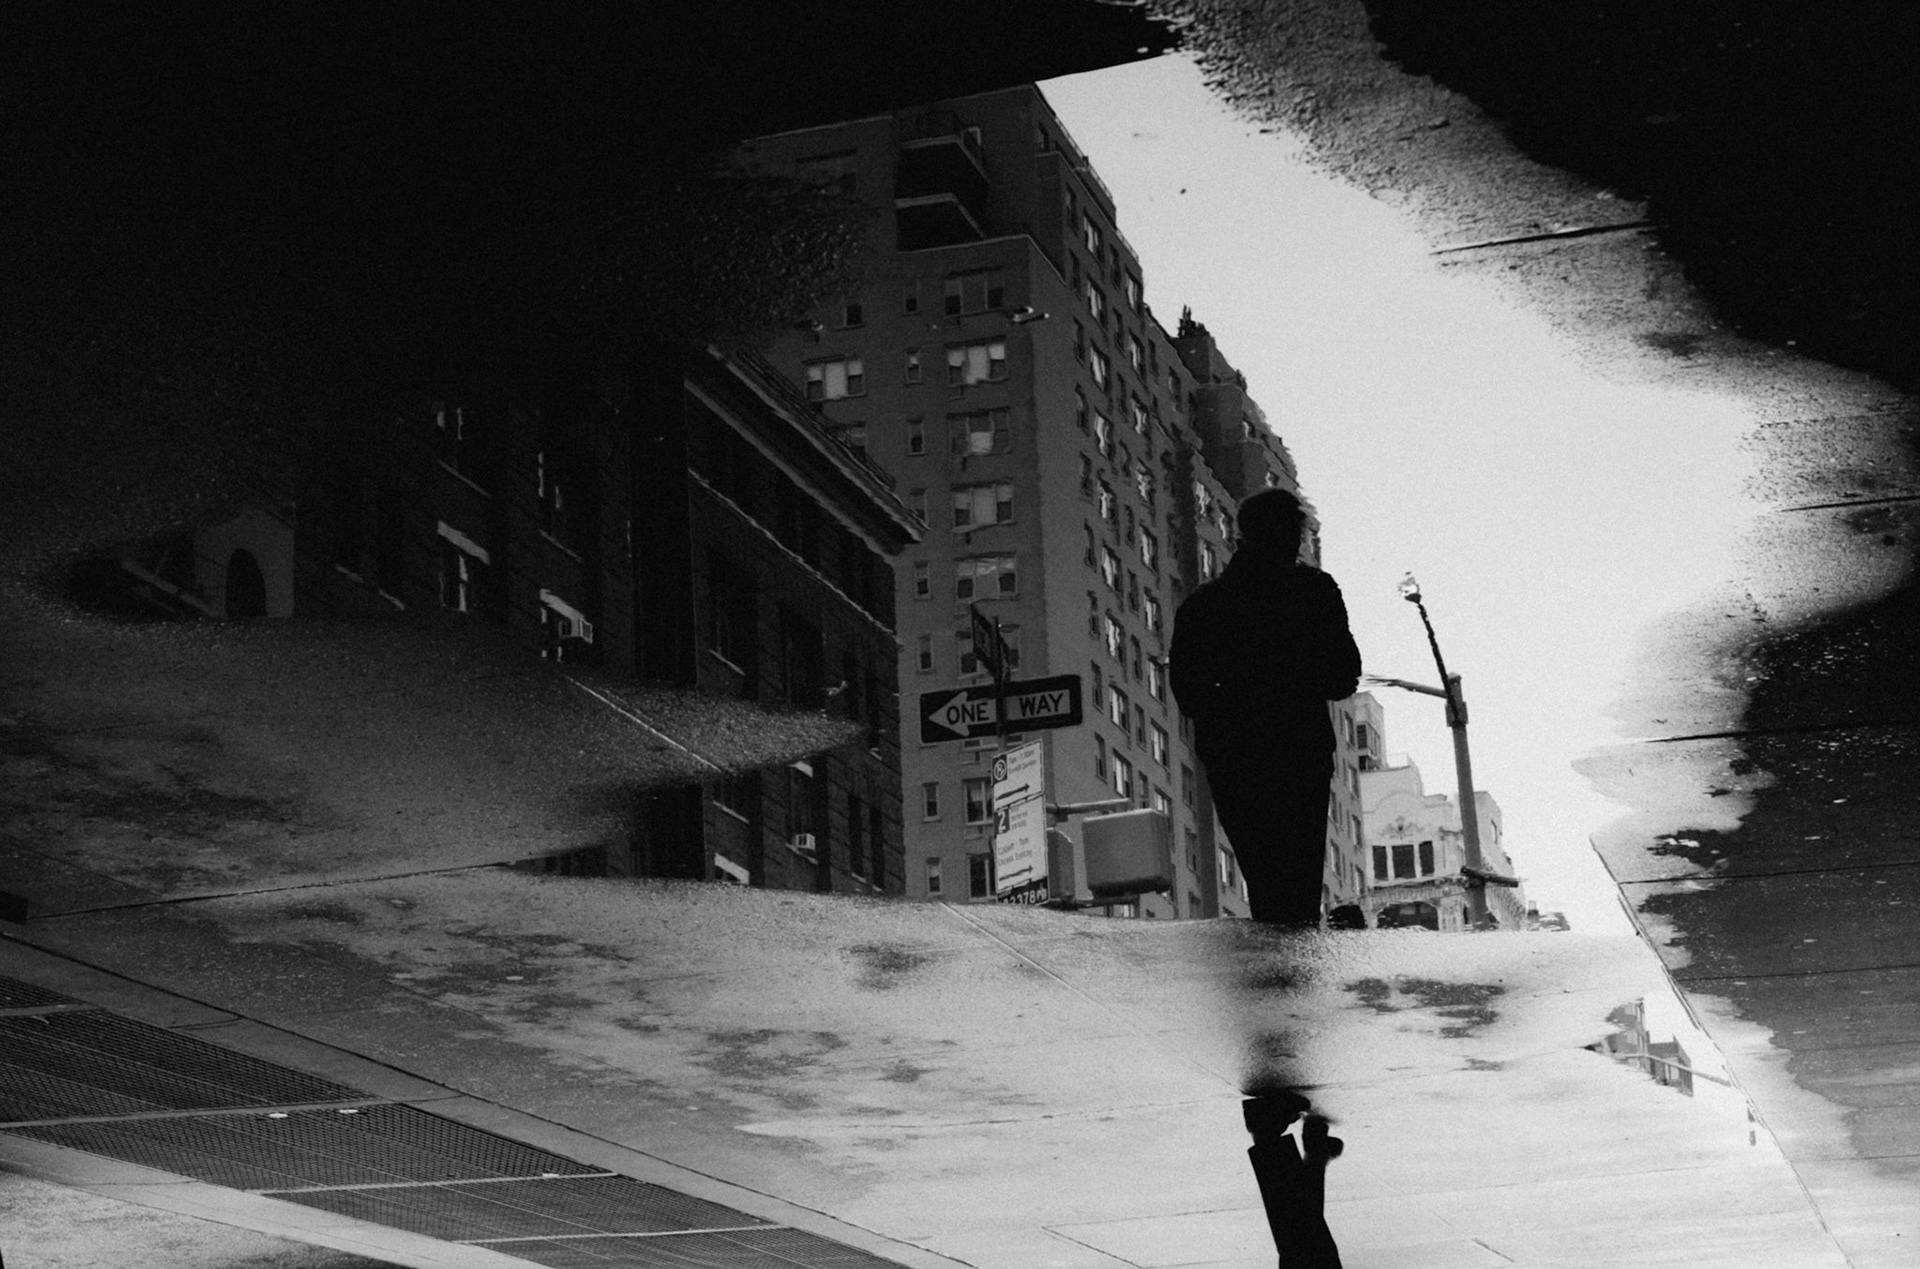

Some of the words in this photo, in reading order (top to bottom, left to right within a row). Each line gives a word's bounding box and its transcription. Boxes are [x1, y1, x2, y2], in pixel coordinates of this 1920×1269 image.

[947, 702, 989, 725] ONE
[1019, 693, 1063, 716] WAY
[998, 811, 1006, 831] 2
